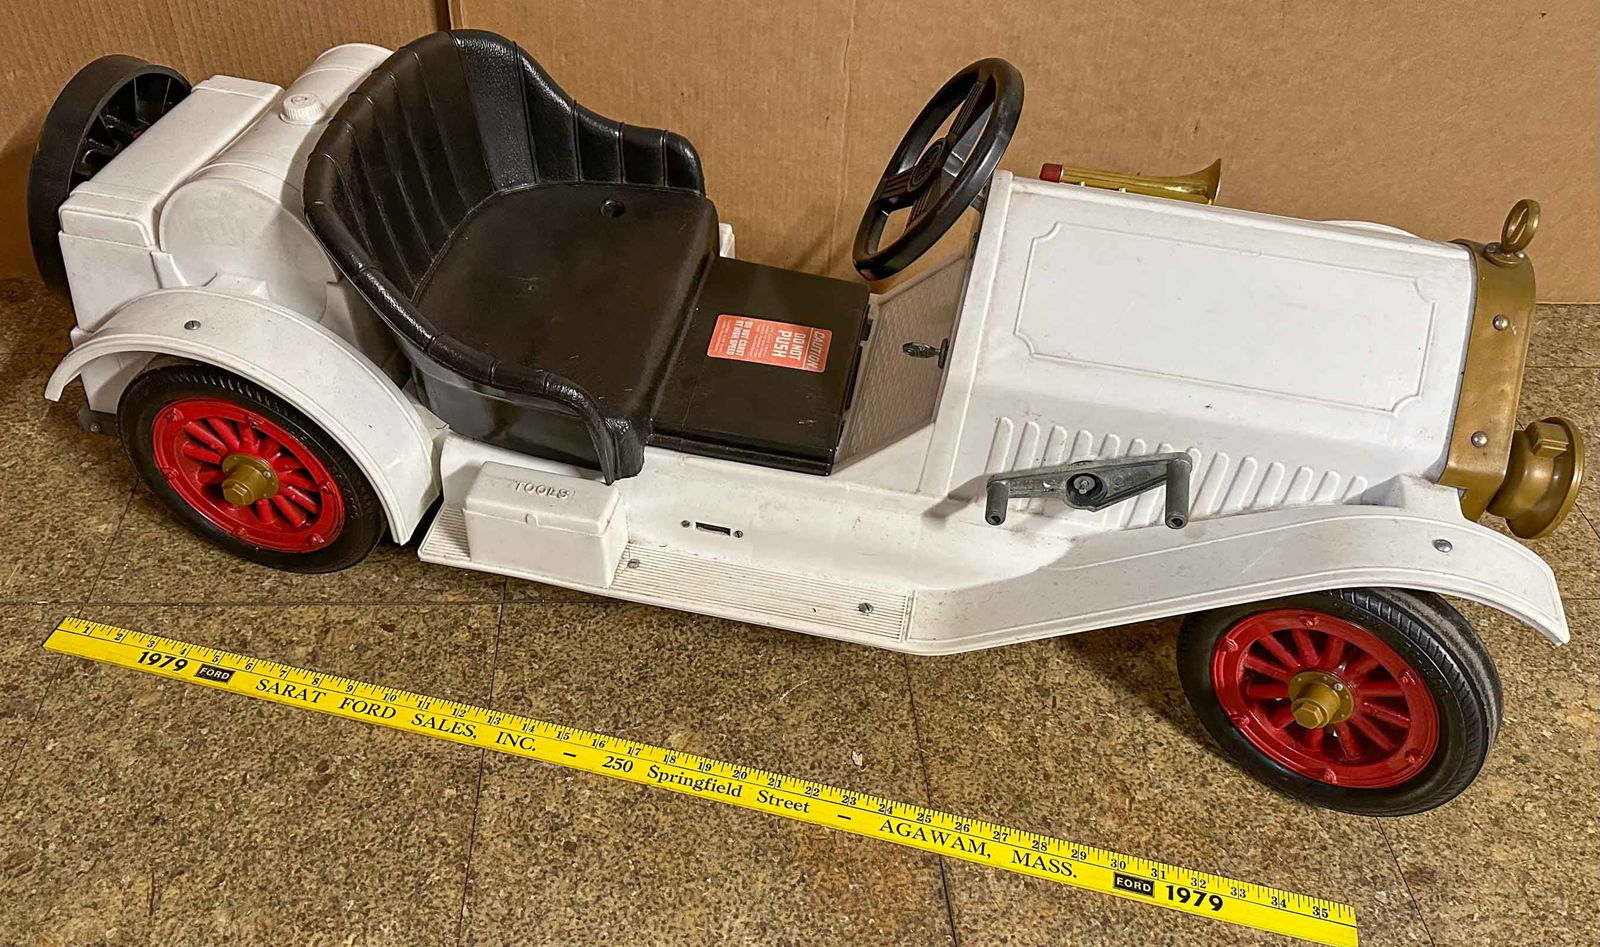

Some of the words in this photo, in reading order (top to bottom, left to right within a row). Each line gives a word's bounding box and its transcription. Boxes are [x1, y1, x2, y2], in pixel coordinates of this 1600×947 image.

[726, 339, 740, 355] SPEED
[771, 330, 793, 358] PUSH
[793, 333, 806, 345] DO
[806, 331, 825, 369] CAUTION
[788, 344, 804, 361] NOT
[515, 480, 570, 500] TOOLS
[114, 632, 124, 641] 2
[147, 639, 155, 649] 3
[179, 647, 187, 656] 4
[212, 654, 220, 663] 5
[245, 661, 252, 670] 6
[279, 669, 287, 678] 7
[311, 676, 319, 685] 8
[347, 684, 354, 693] 9
[383, 692, 397, 702] 10
[417, 700, 430, 710] 11
[451, 707, 466, 718] 12
[487, 715, 501, 725] 13
[522, 723, 535, 733] 14
[556, 730, 570, 741] 15
[591, 738, 606, 749] 16
[627, 746, 641, 756] 17
[663, 754, 677, 764] 18
[698, 762, 712, 772] 19
[733, 769, 747, 780] 20
[768, 777, 782, 788] 21
[804, 786, 820, 797] 22
[841, 795, 857, 806] 23
[877, 804, 893, 815] 24
[916, 813, 932, 824] 25
[954, 822, 970, 833] 26
[993, 831, 1009, 842] 27
[1032, 840, 1048, 851] 28
[1071, 849, 1087, 861] 29
[1110, 859, 1127, 870] 30
[1150, 868, 1166, 880] 31
[1190, 877, 1207, 889] 32
[1230, 886, 1247, 899] 33
[1271, 896, 1287, 909] 34
[1312, 906, 1329, 918] 35
[137, 651, 189, 672] 1979
[199, 667, 230, 680] FORD
[255, 679, 326, 704] SARAT
[338, 697, 396, 720] FORD
[411, 713, 477, 740] SALES,
[495, 731, 536, 751] INC.
[601, 755, 634, 773] 250
[647, 765, 743, 798] Springfield
[756, 789, 810, 814] Street
[880, 819, 991, 859] AGAWAM,
[1011, 850, 1078, 879] MASS.
[1116, 877, 1151, 893] FORD
[1166, 885, 1224, 912] 1979
